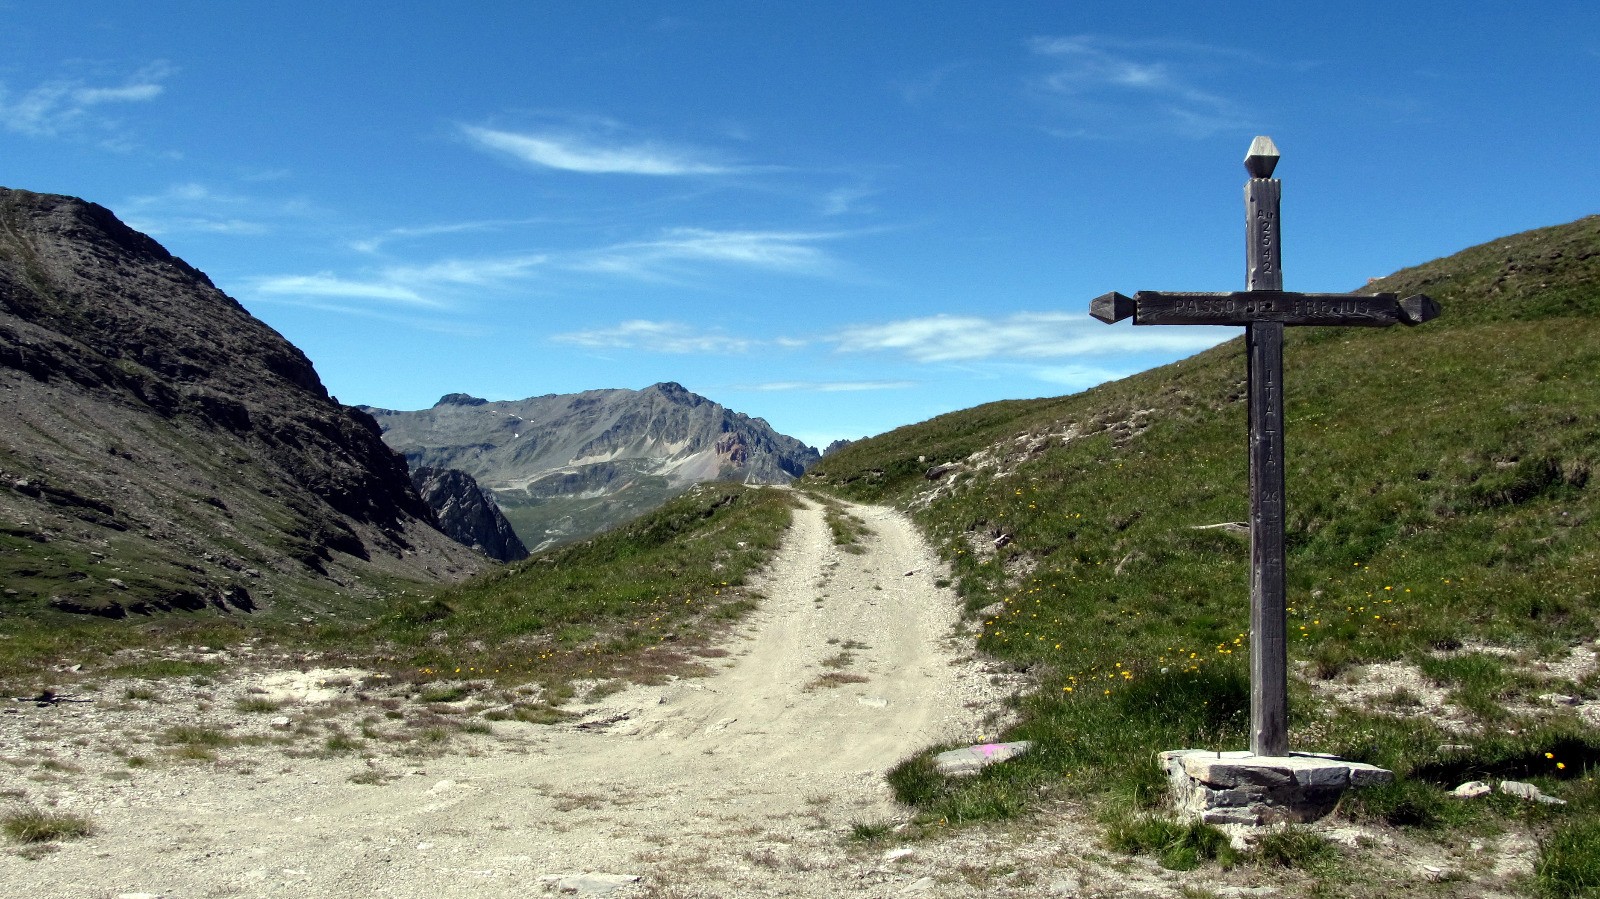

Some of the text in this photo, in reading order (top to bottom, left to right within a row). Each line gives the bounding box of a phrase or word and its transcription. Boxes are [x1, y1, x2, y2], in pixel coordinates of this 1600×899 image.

[1262, 220, 1272, 274] 2542
[1174, 299, 1370, 314] PASSO DEL FREJUS
[1264, 368, 1277, 470] ITALIA
